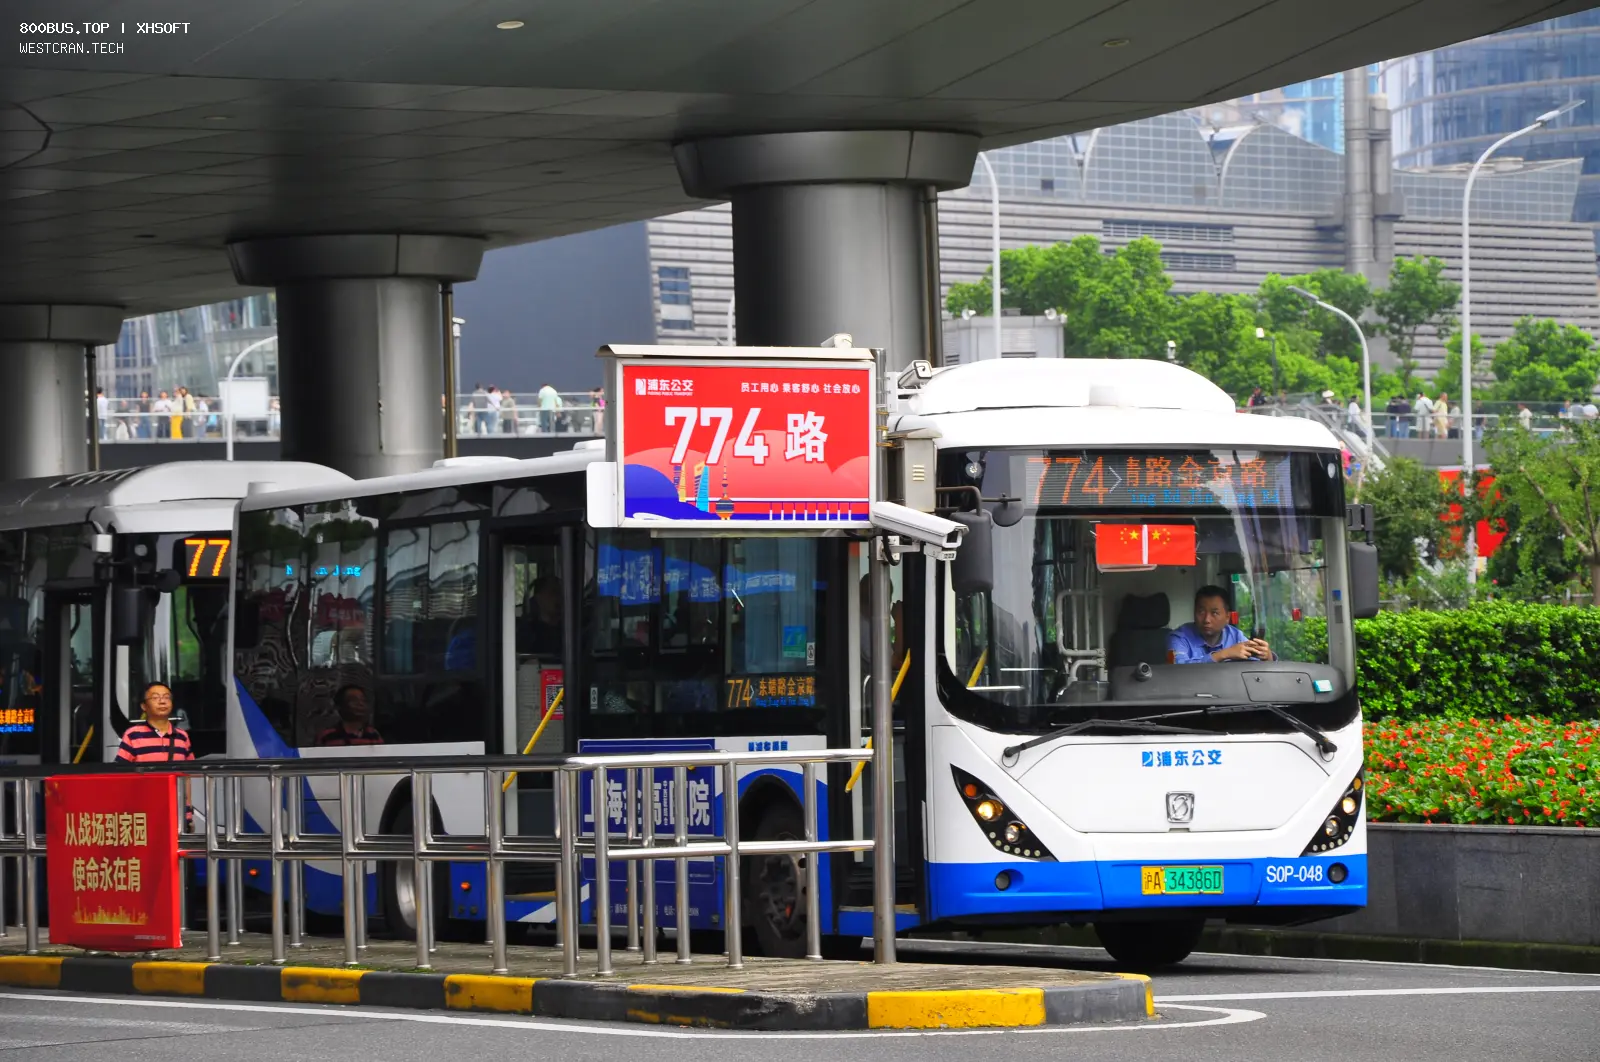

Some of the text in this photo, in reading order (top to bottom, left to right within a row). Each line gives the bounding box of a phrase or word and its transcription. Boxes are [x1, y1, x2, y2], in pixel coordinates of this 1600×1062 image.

[647, 378, 694, 392] 浦东公交
[664, 406, 829, 465] 774 路
[1027, 456, 1109, 504] 774
[727, 678, 751, 707] 774
[1157, 749, 1222, 767] 浦东公交
[65, 812, 147, 847] 从战场到家园
[72, 857, 141, 892] 使命永在肩
